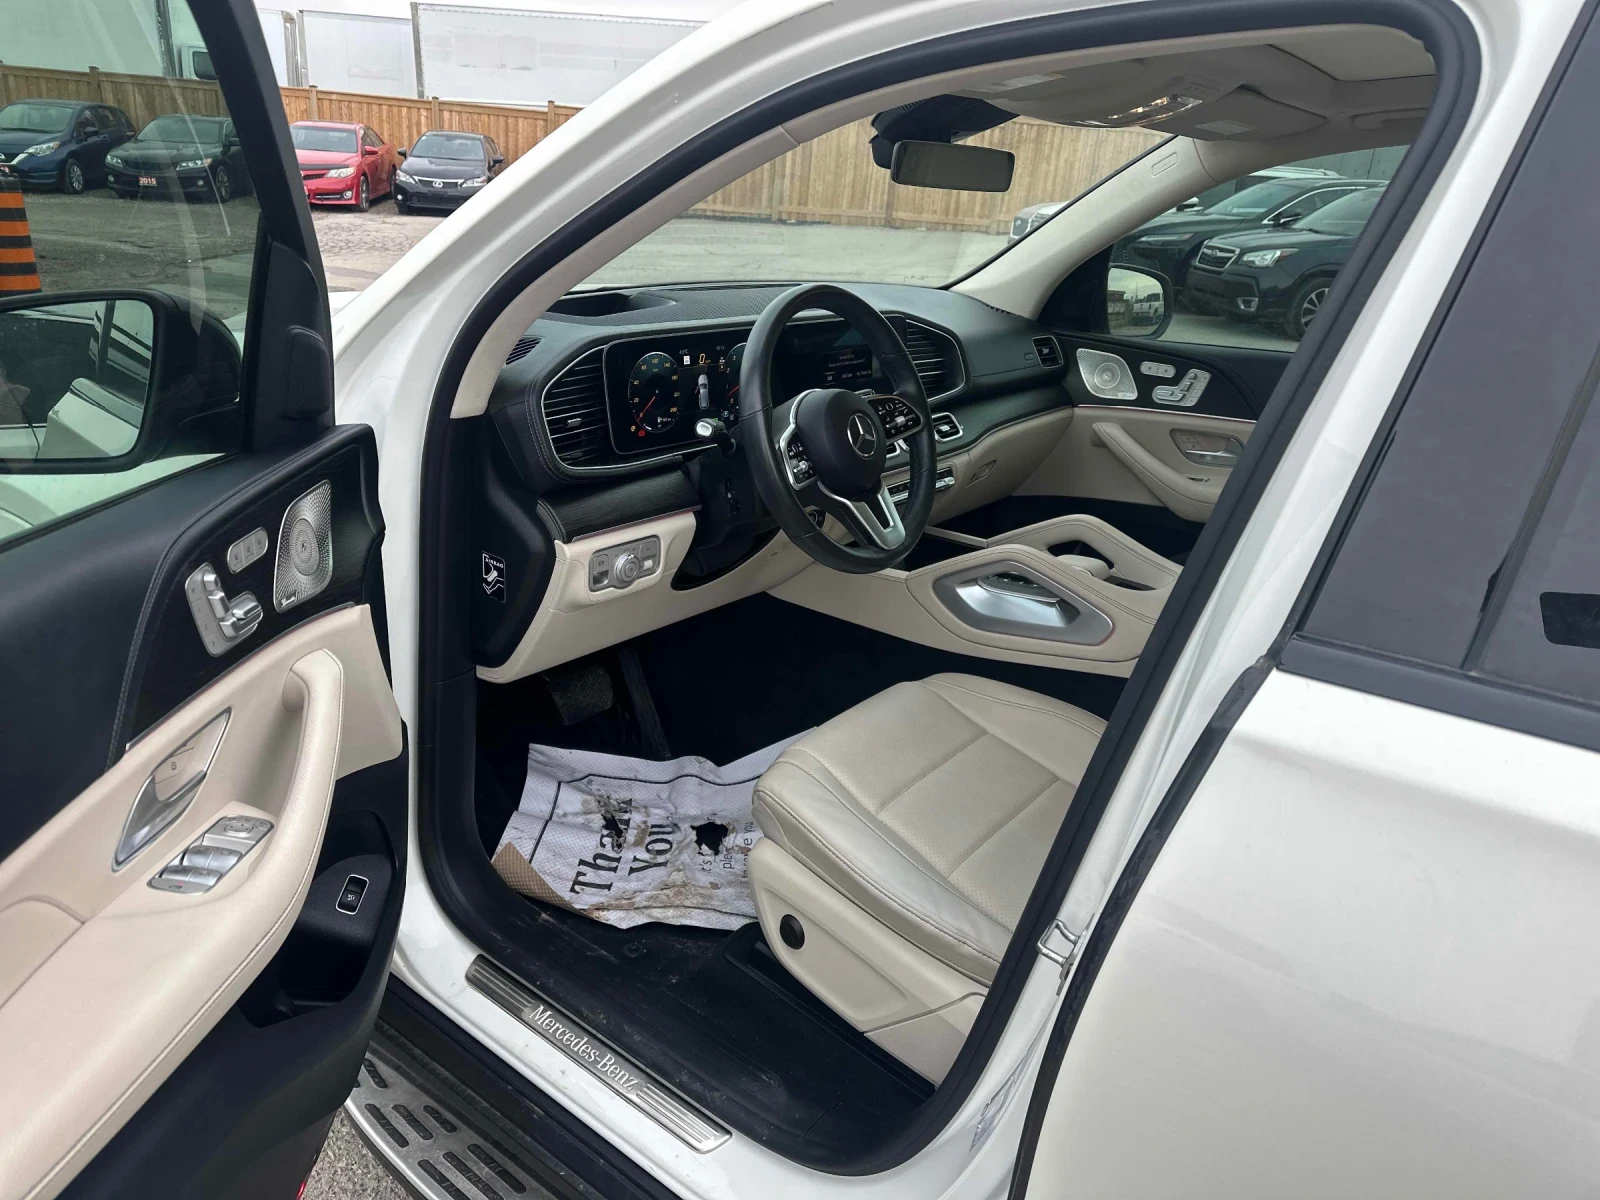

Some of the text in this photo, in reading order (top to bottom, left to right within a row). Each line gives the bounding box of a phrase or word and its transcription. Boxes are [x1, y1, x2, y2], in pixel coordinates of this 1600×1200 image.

[139, 177, 157, 185] 2015
[627, 822, 681, 877] You
[528, 1003, 639, 1092] Mercedes-Benz
